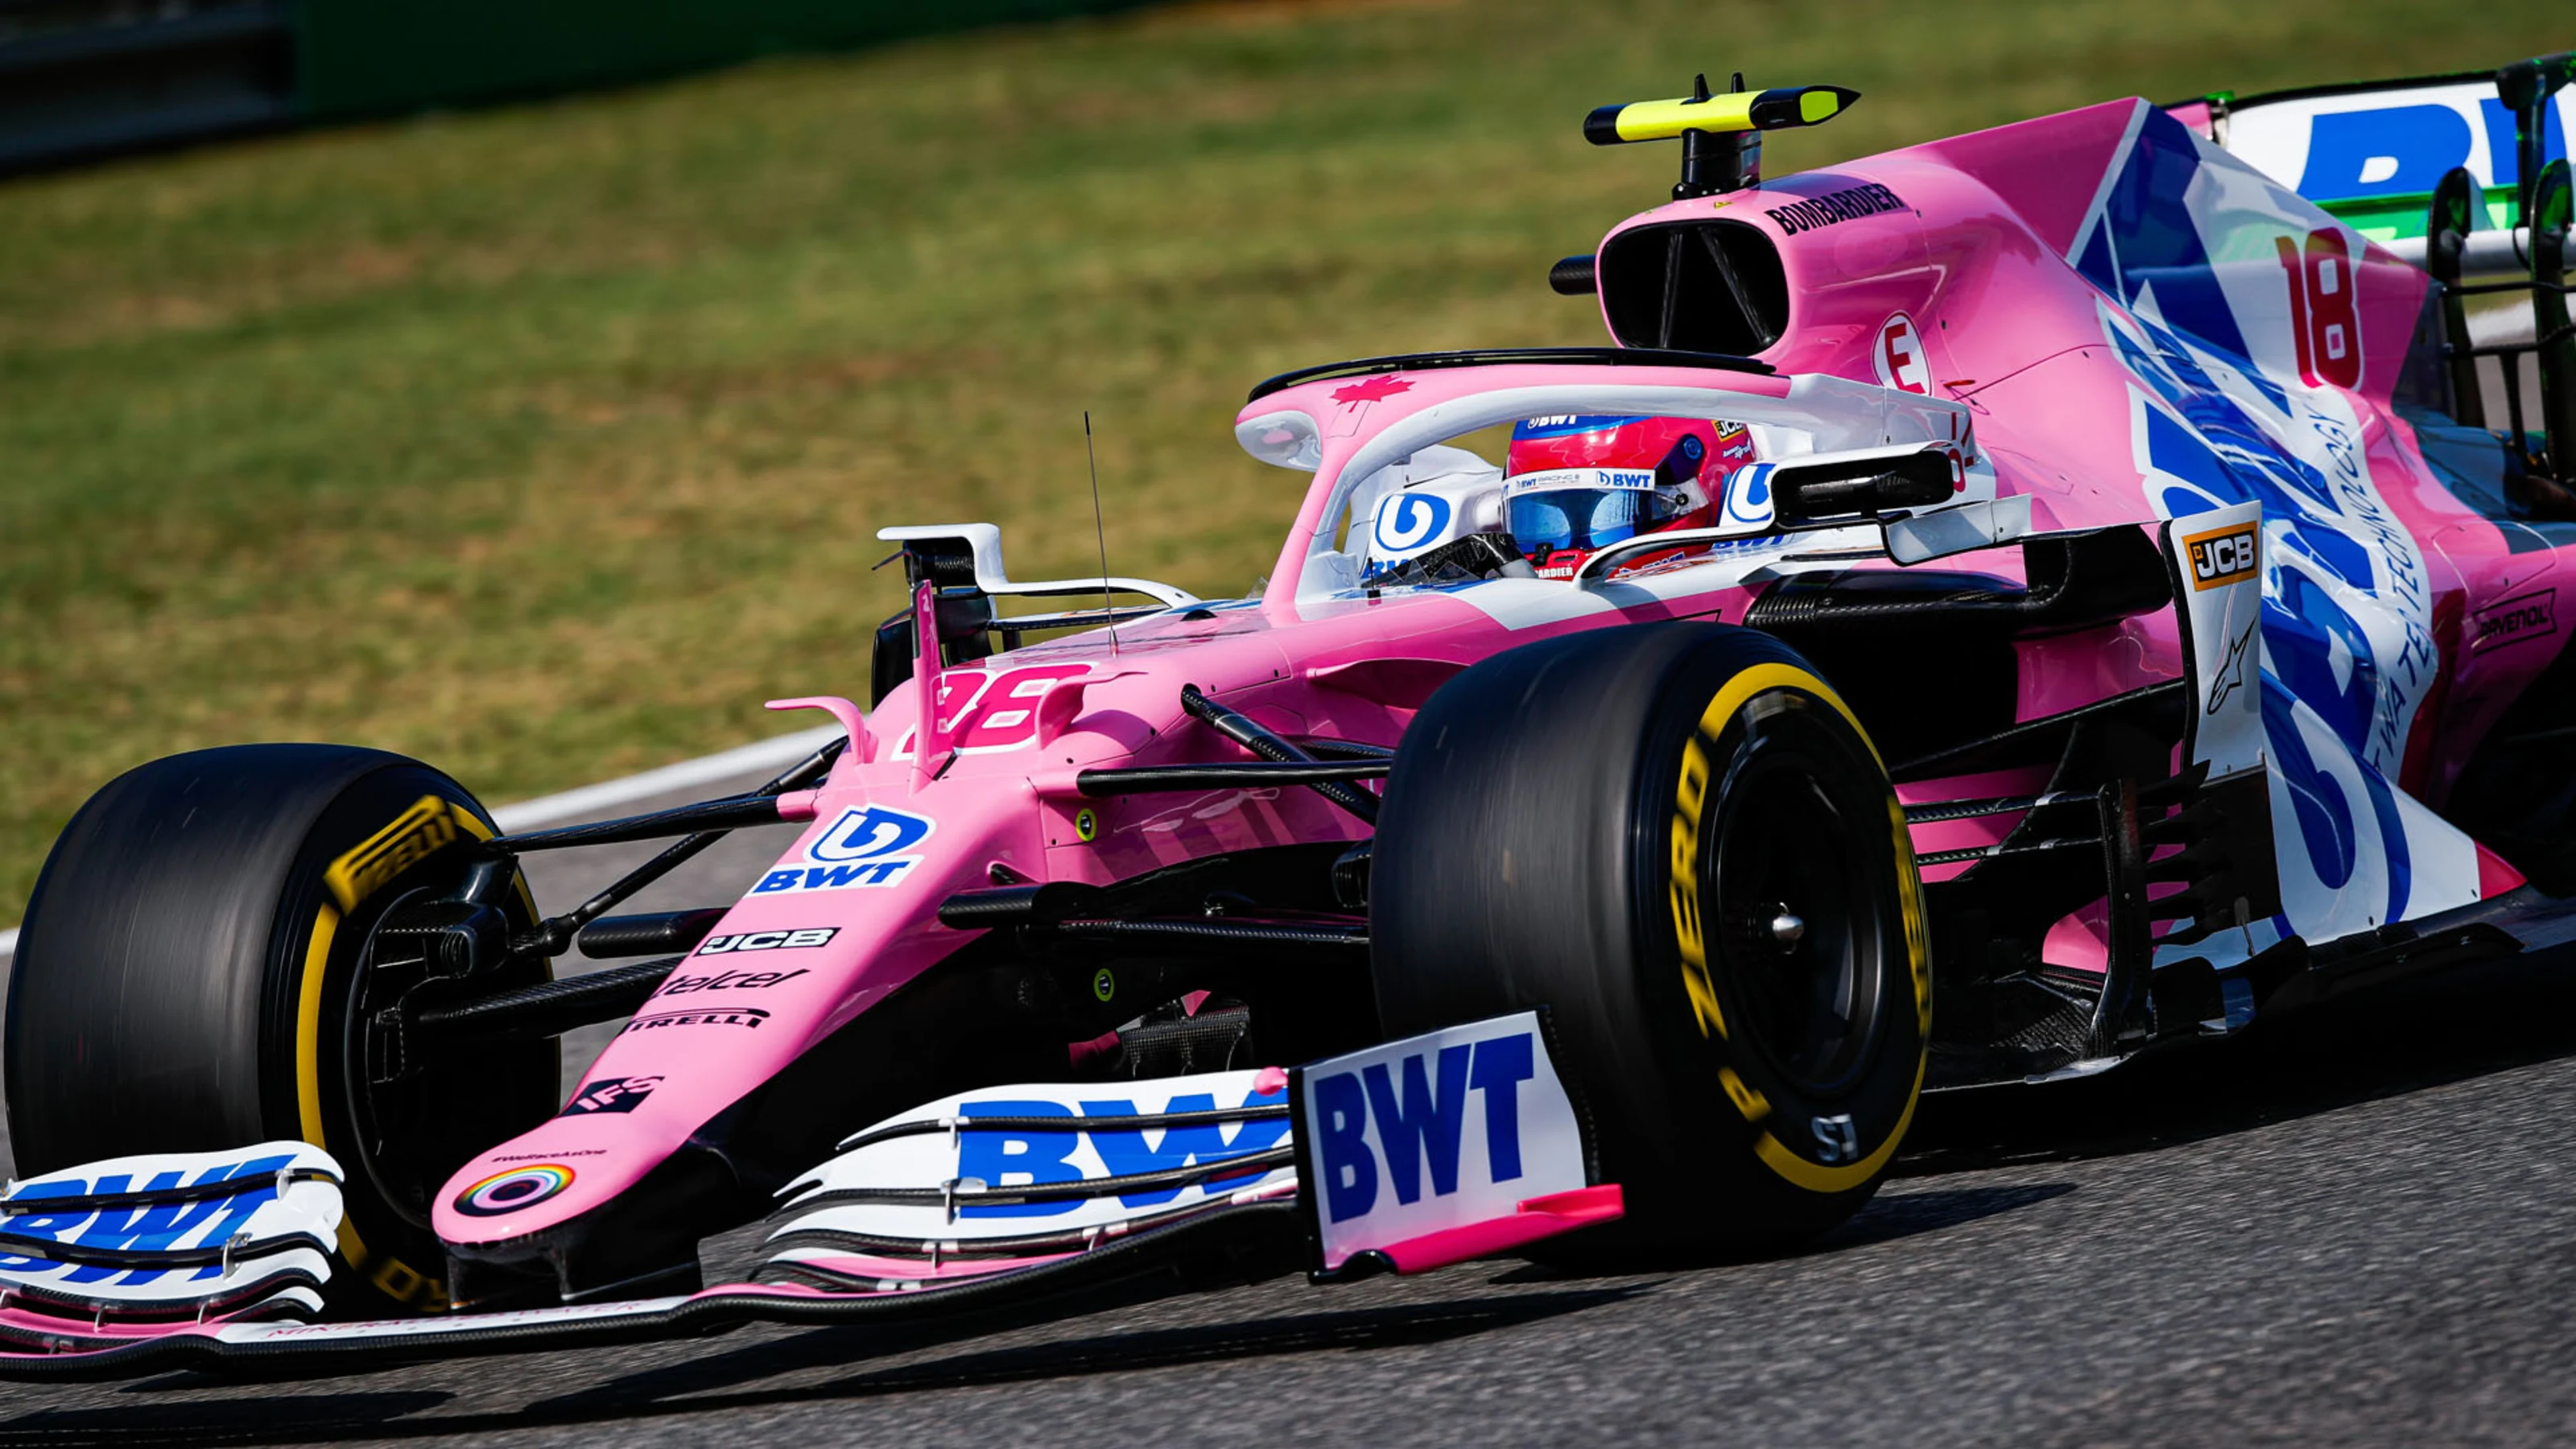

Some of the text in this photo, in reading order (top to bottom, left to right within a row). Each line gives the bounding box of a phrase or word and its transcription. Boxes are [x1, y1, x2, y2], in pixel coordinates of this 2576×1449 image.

[1765, 184, 1905, 237] BOMBARDIER
[2274, 226, 2364, 390] 18
[1613, 474, 1650, 488] BWT
[2308, 405, 2421, 613] TECHNOLOGY
[1535, 567, 1574, 578] ARDIER
[2197, 534, 2255, 578] JCB
[753, 861, 911, 894] BWT
[1670, 736, 1728, 1040] ZERO
[699, 928, 835, 956] JCB
[649, 968, 811, 999] telcel
[577, 1076, 658, 1111] IFS
[1312, 1031, 1534, 1224] BWT
[957, 1088, 1293, 1219] BW
